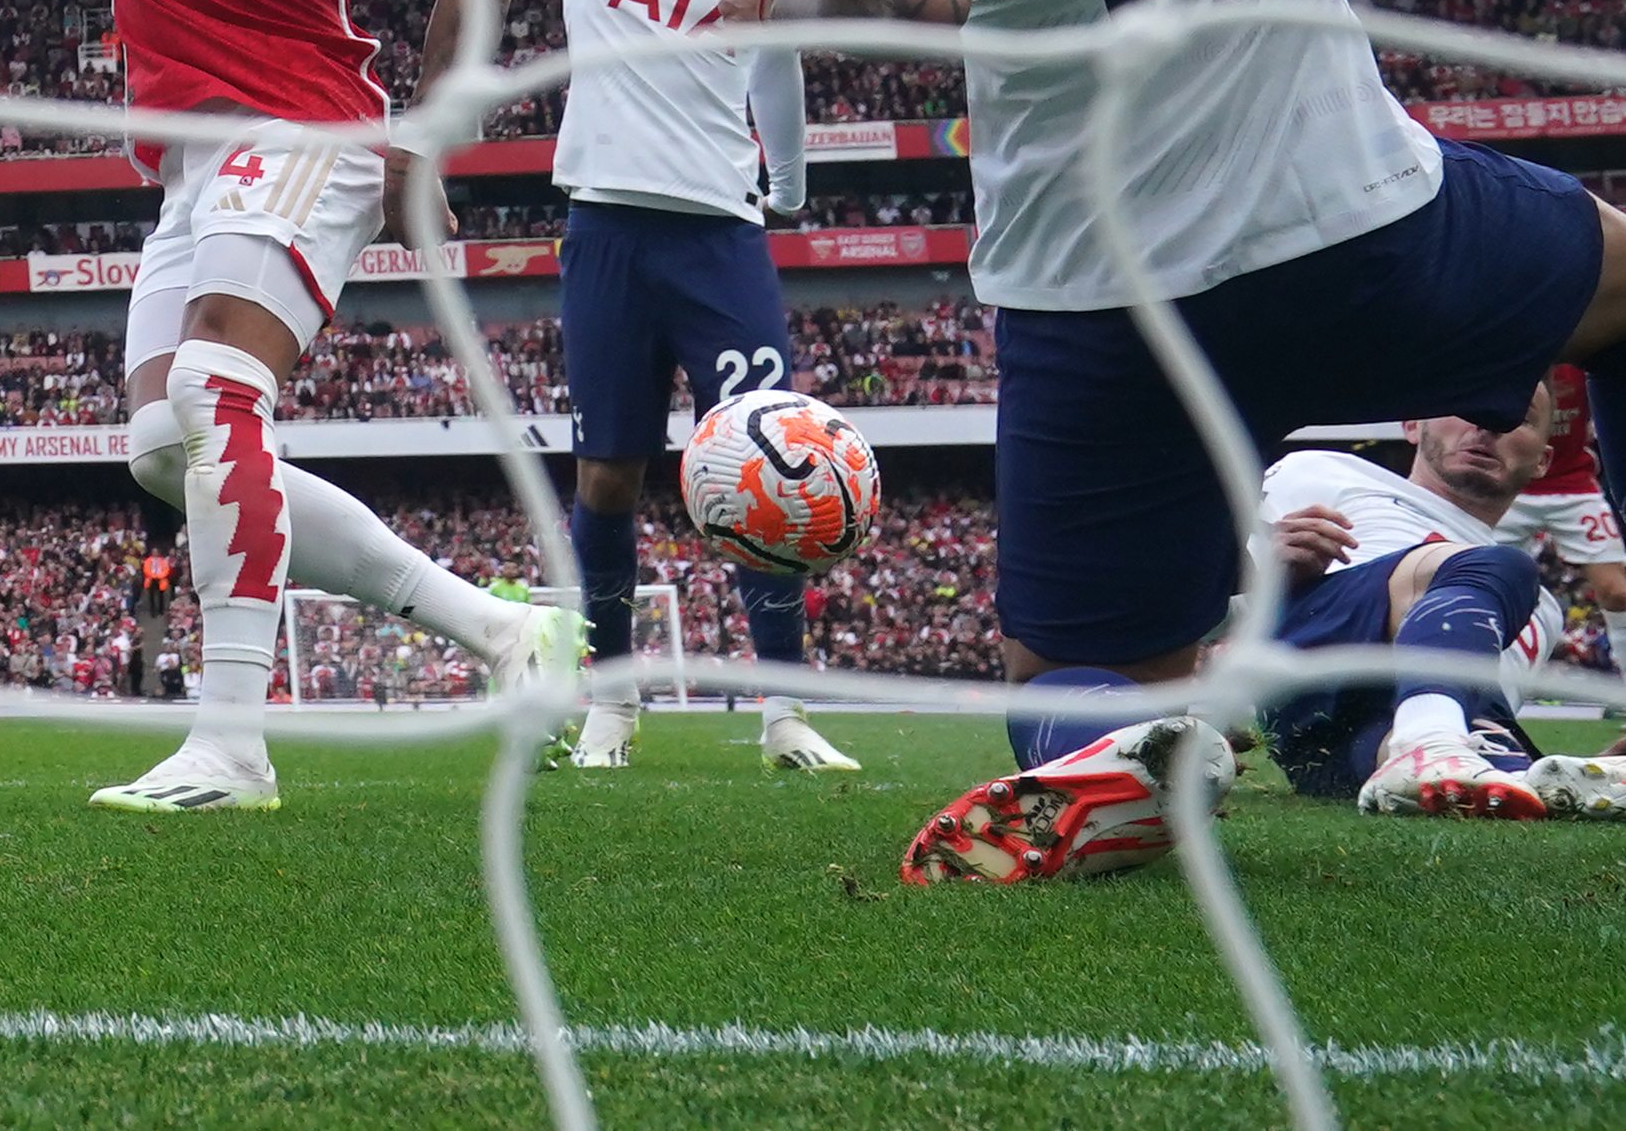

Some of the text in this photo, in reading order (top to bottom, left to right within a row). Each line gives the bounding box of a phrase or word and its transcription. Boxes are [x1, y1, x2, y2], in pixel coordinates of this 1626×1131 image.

[218, 140, 265, 186] 4
[715, 346, 785, 402] 22
[25, 435, 103, 457] ARSENAL
[108, 434, 130, 456] RE
